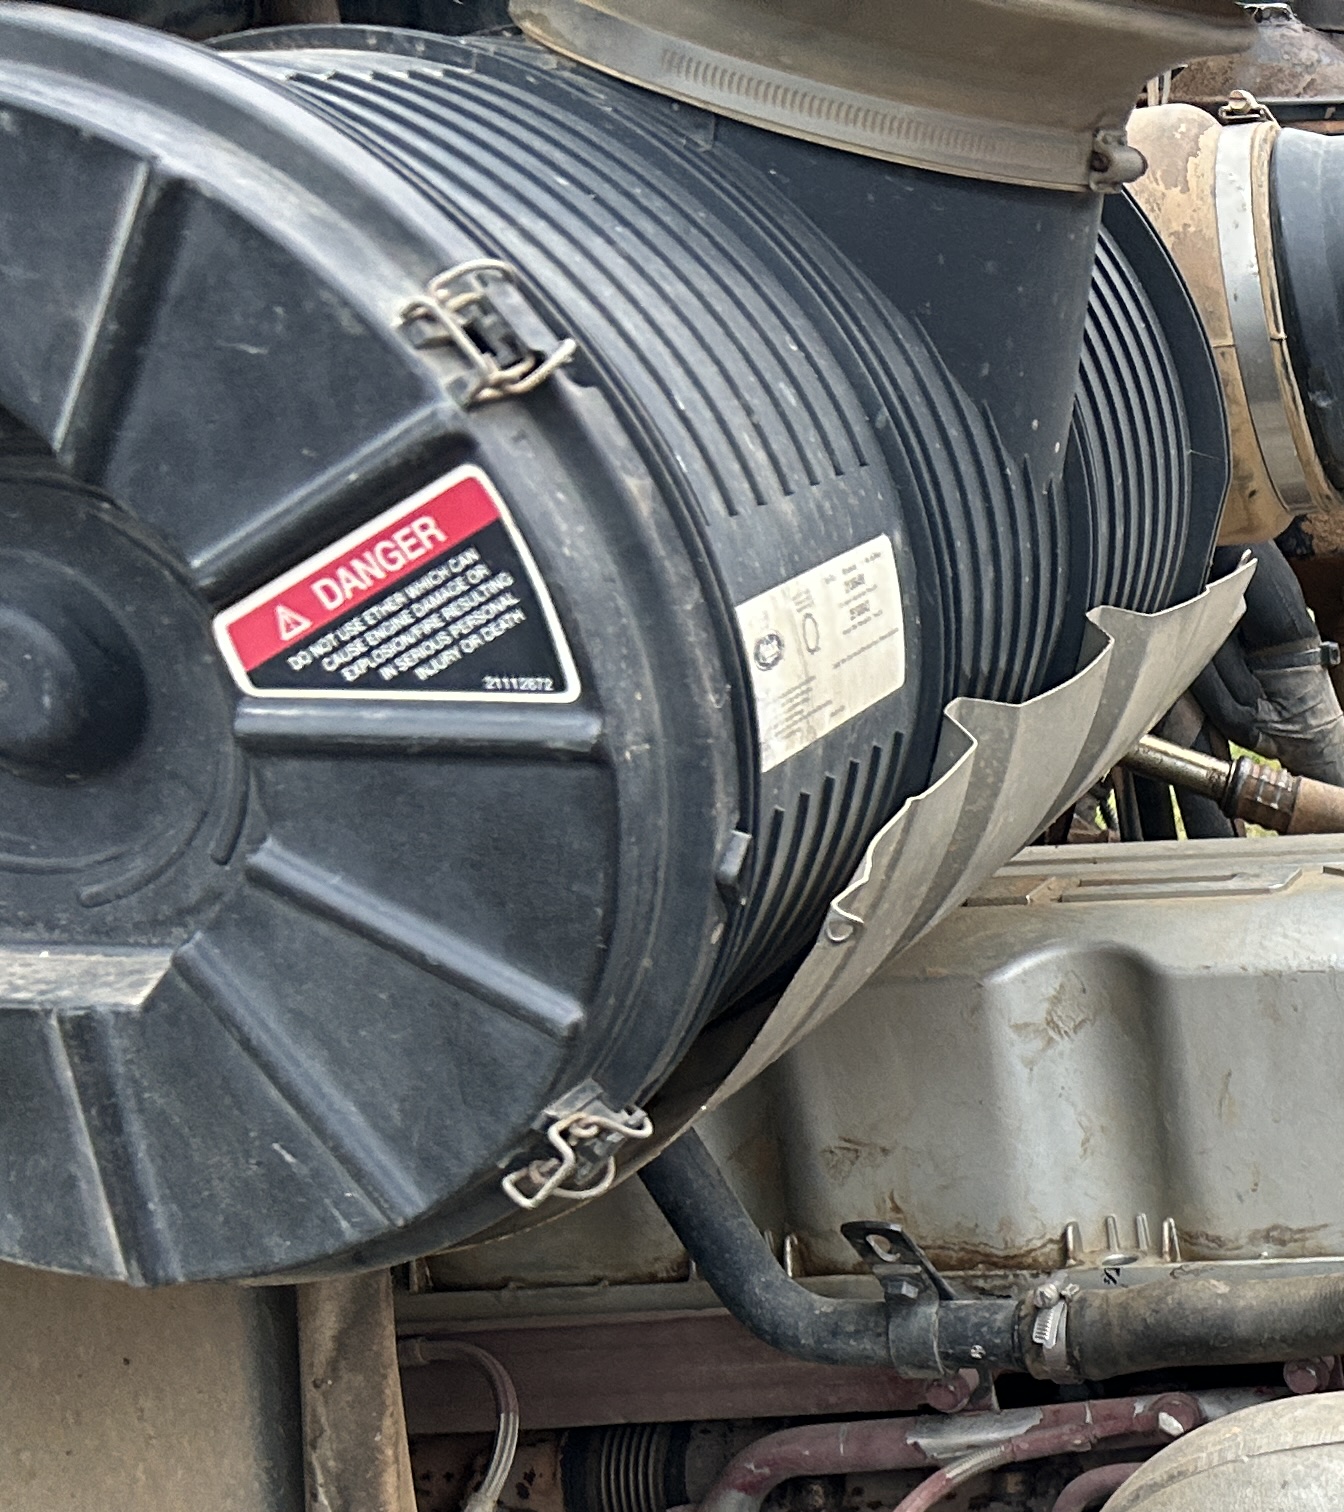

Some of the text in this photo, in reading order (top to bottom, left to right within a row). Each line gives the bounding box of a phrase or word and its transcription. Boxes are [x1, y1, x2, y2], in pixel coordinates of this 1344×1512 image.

[287, 546, 479, 671] DO NOT USE ETHER WHICH CAN
[310, 515, 446, 609] DANGER
[321, 562, 489, 672] CAUSE ENGINE DAMAGE OR
[340, 569, 513, 682] EXPLOSION/FIRE RESULTING
[379, 589, 518, 680] IN SERIOUS PERSONAL
[414, 607, 525, 680] INJURY OR DEATH
